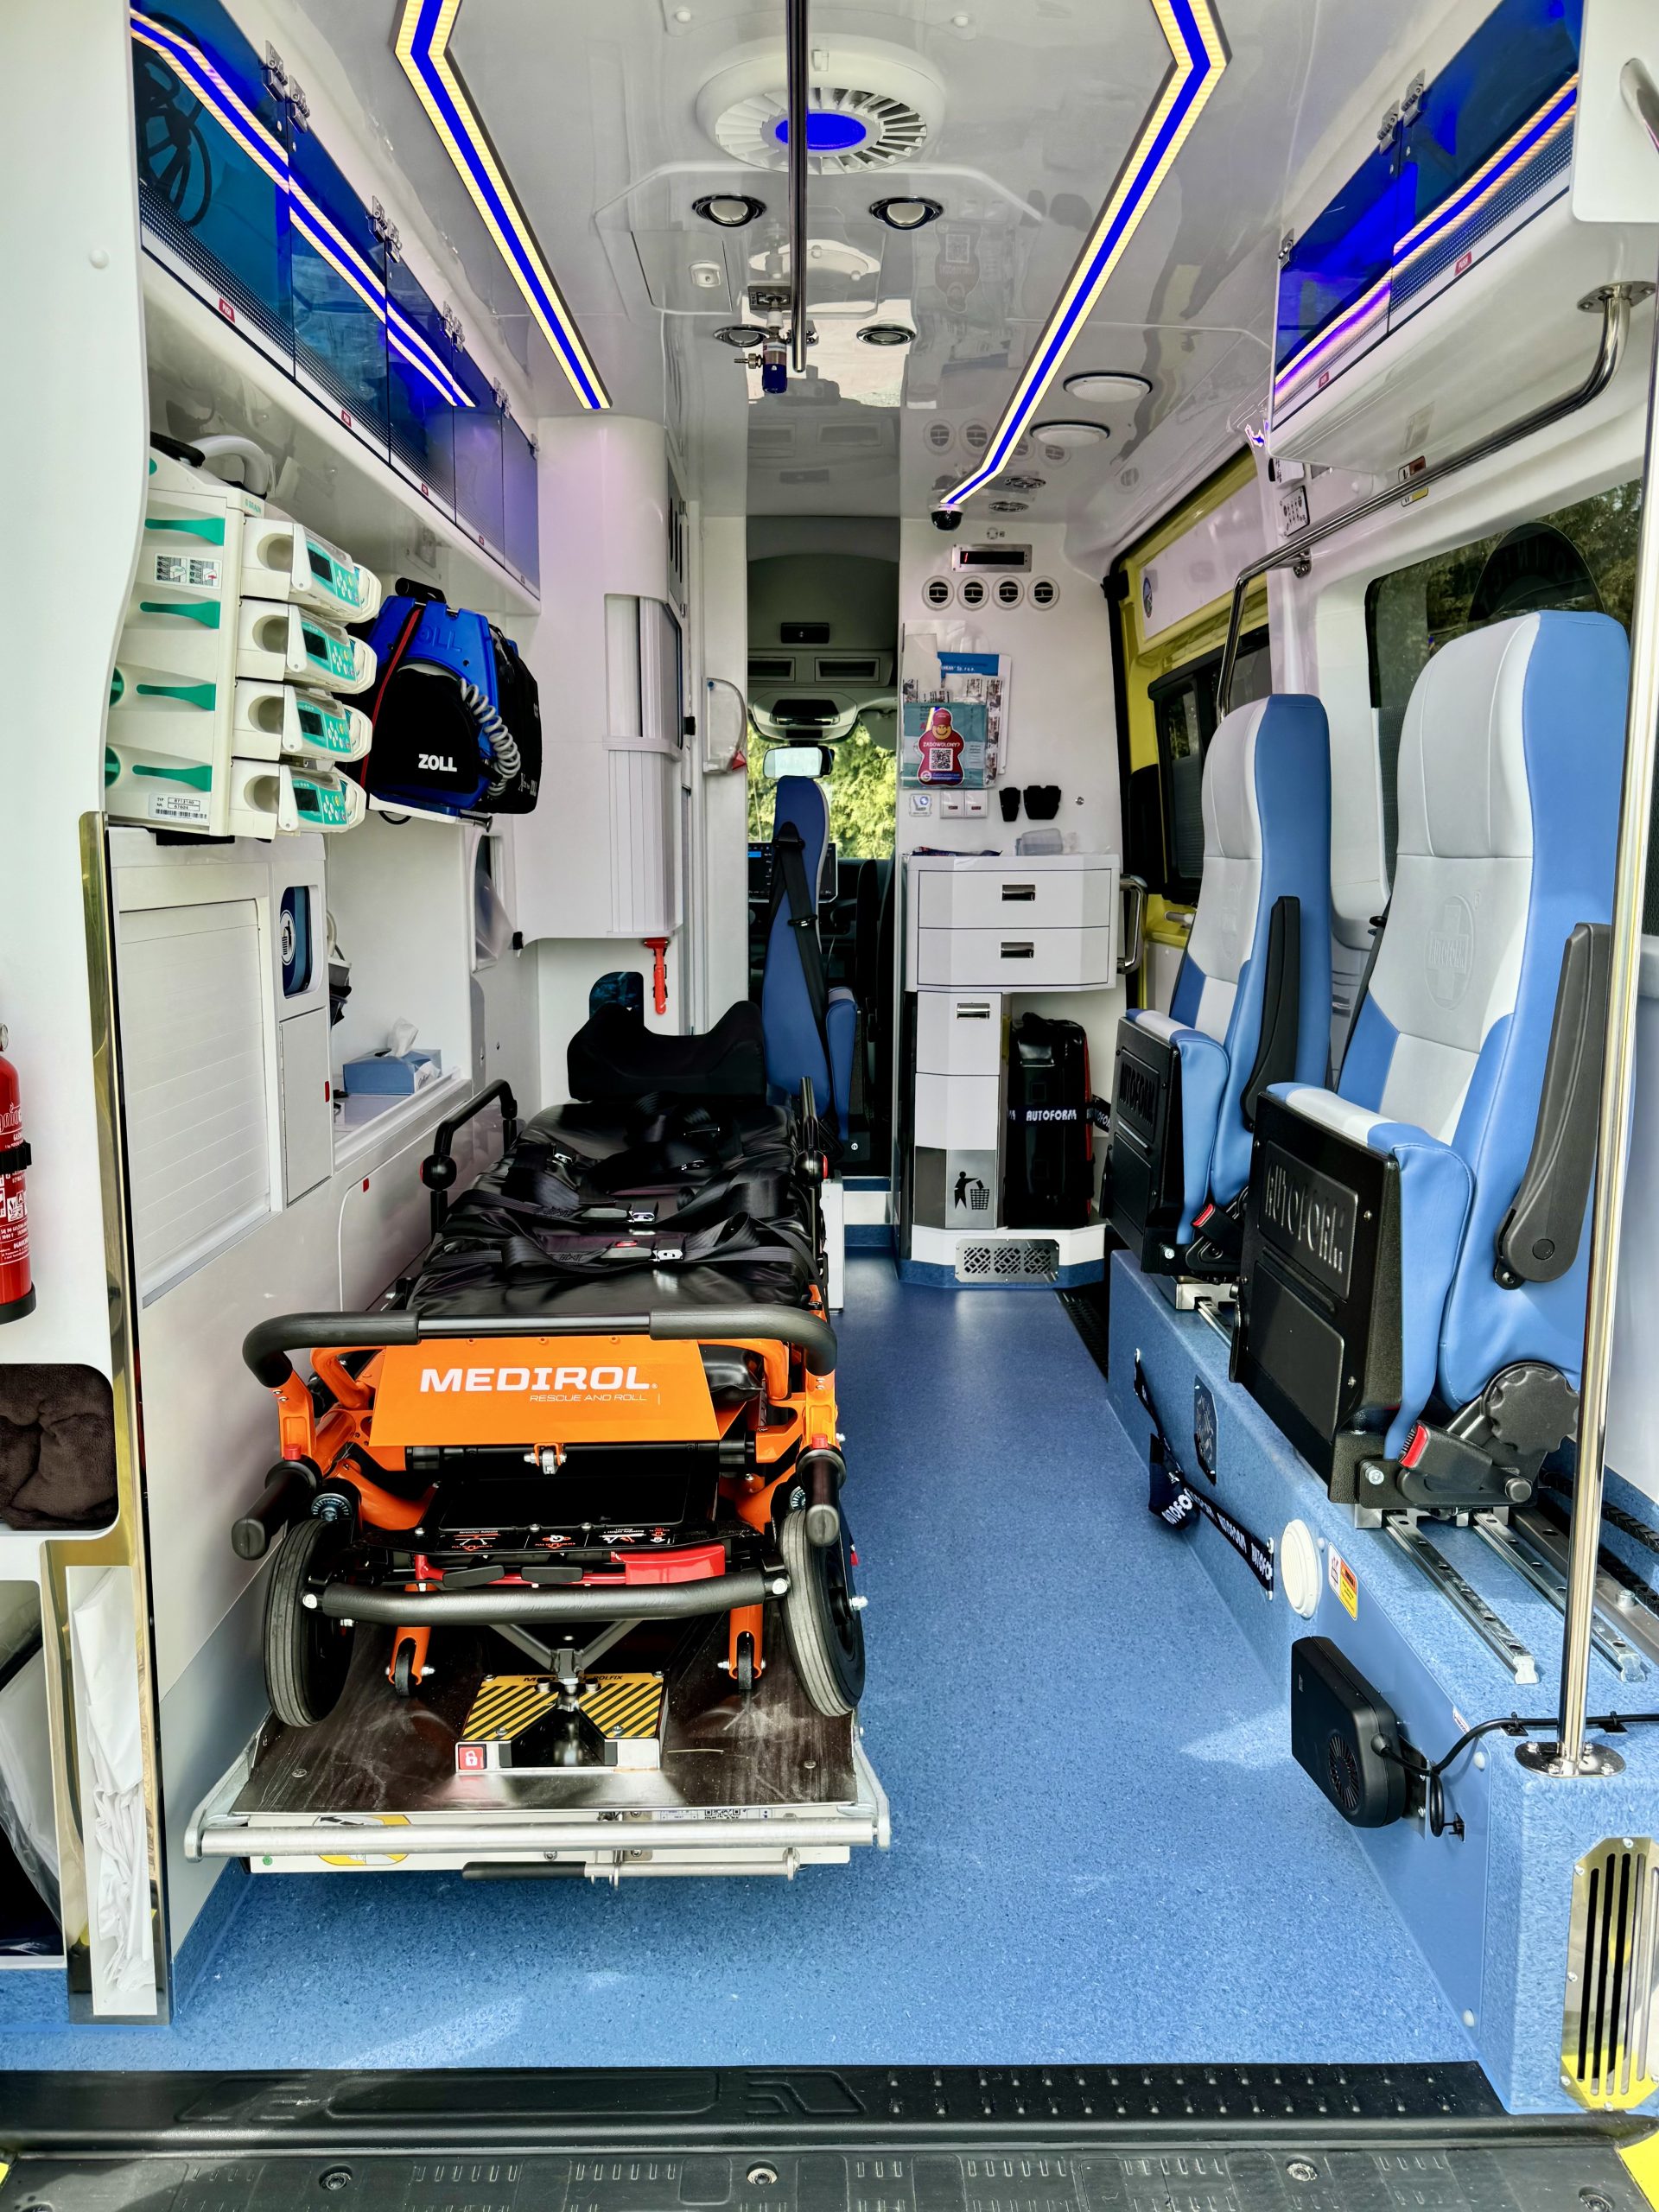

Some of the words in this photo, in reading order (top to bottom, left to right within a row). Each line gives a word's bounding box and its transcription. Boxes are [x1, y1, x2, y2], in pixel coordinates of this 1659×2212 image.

[417, 623, 463, 653] OLL
[418, 753, 458, 772] ZOLL
[1027, 1109, 1077, 1122] AUTOFORM
[420, 1366, 650, 1393] MEDIROL
[530, 1394, 582, 1402] RESCUE
[613, 1393, 646, 1402] ROLL
